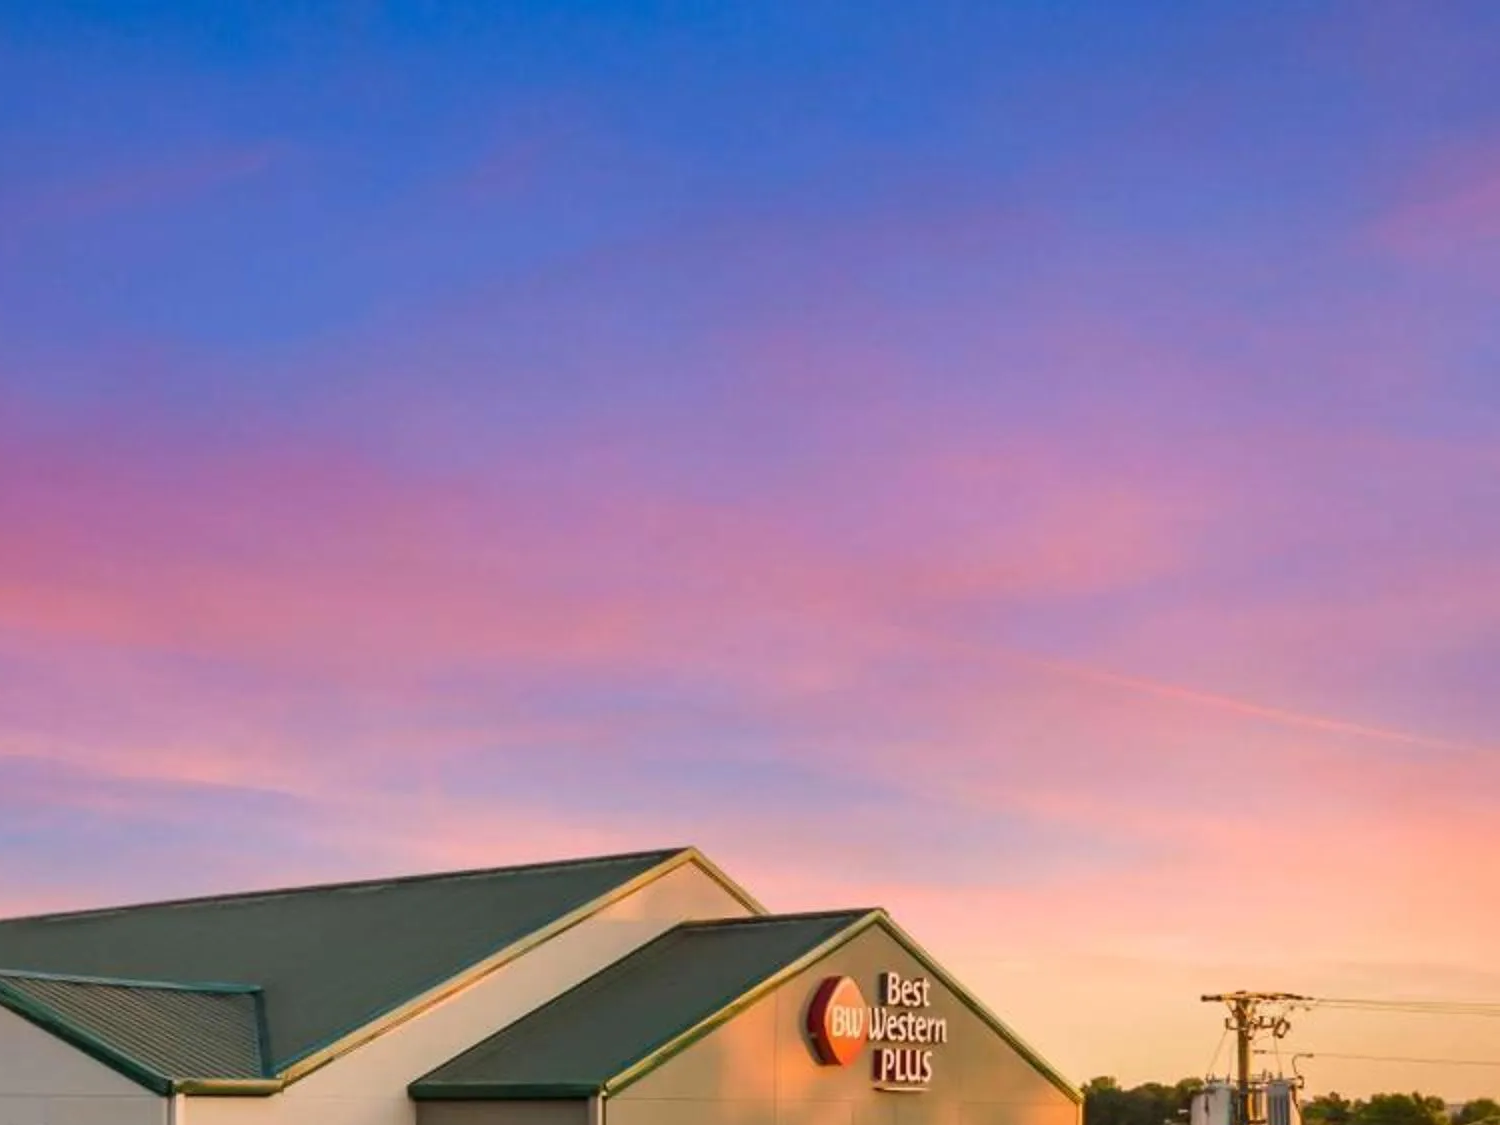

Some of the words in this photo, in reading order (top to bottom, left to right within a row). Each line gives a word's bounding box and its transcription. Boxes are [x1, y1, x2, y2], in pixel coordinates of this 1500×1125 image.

[886, 971, 931, 1008] Best
[831, 1005, 864, 1038] BW
[867, 1006, 948, 1044] Western
[880, 1048, 933, 1083] PLUS
